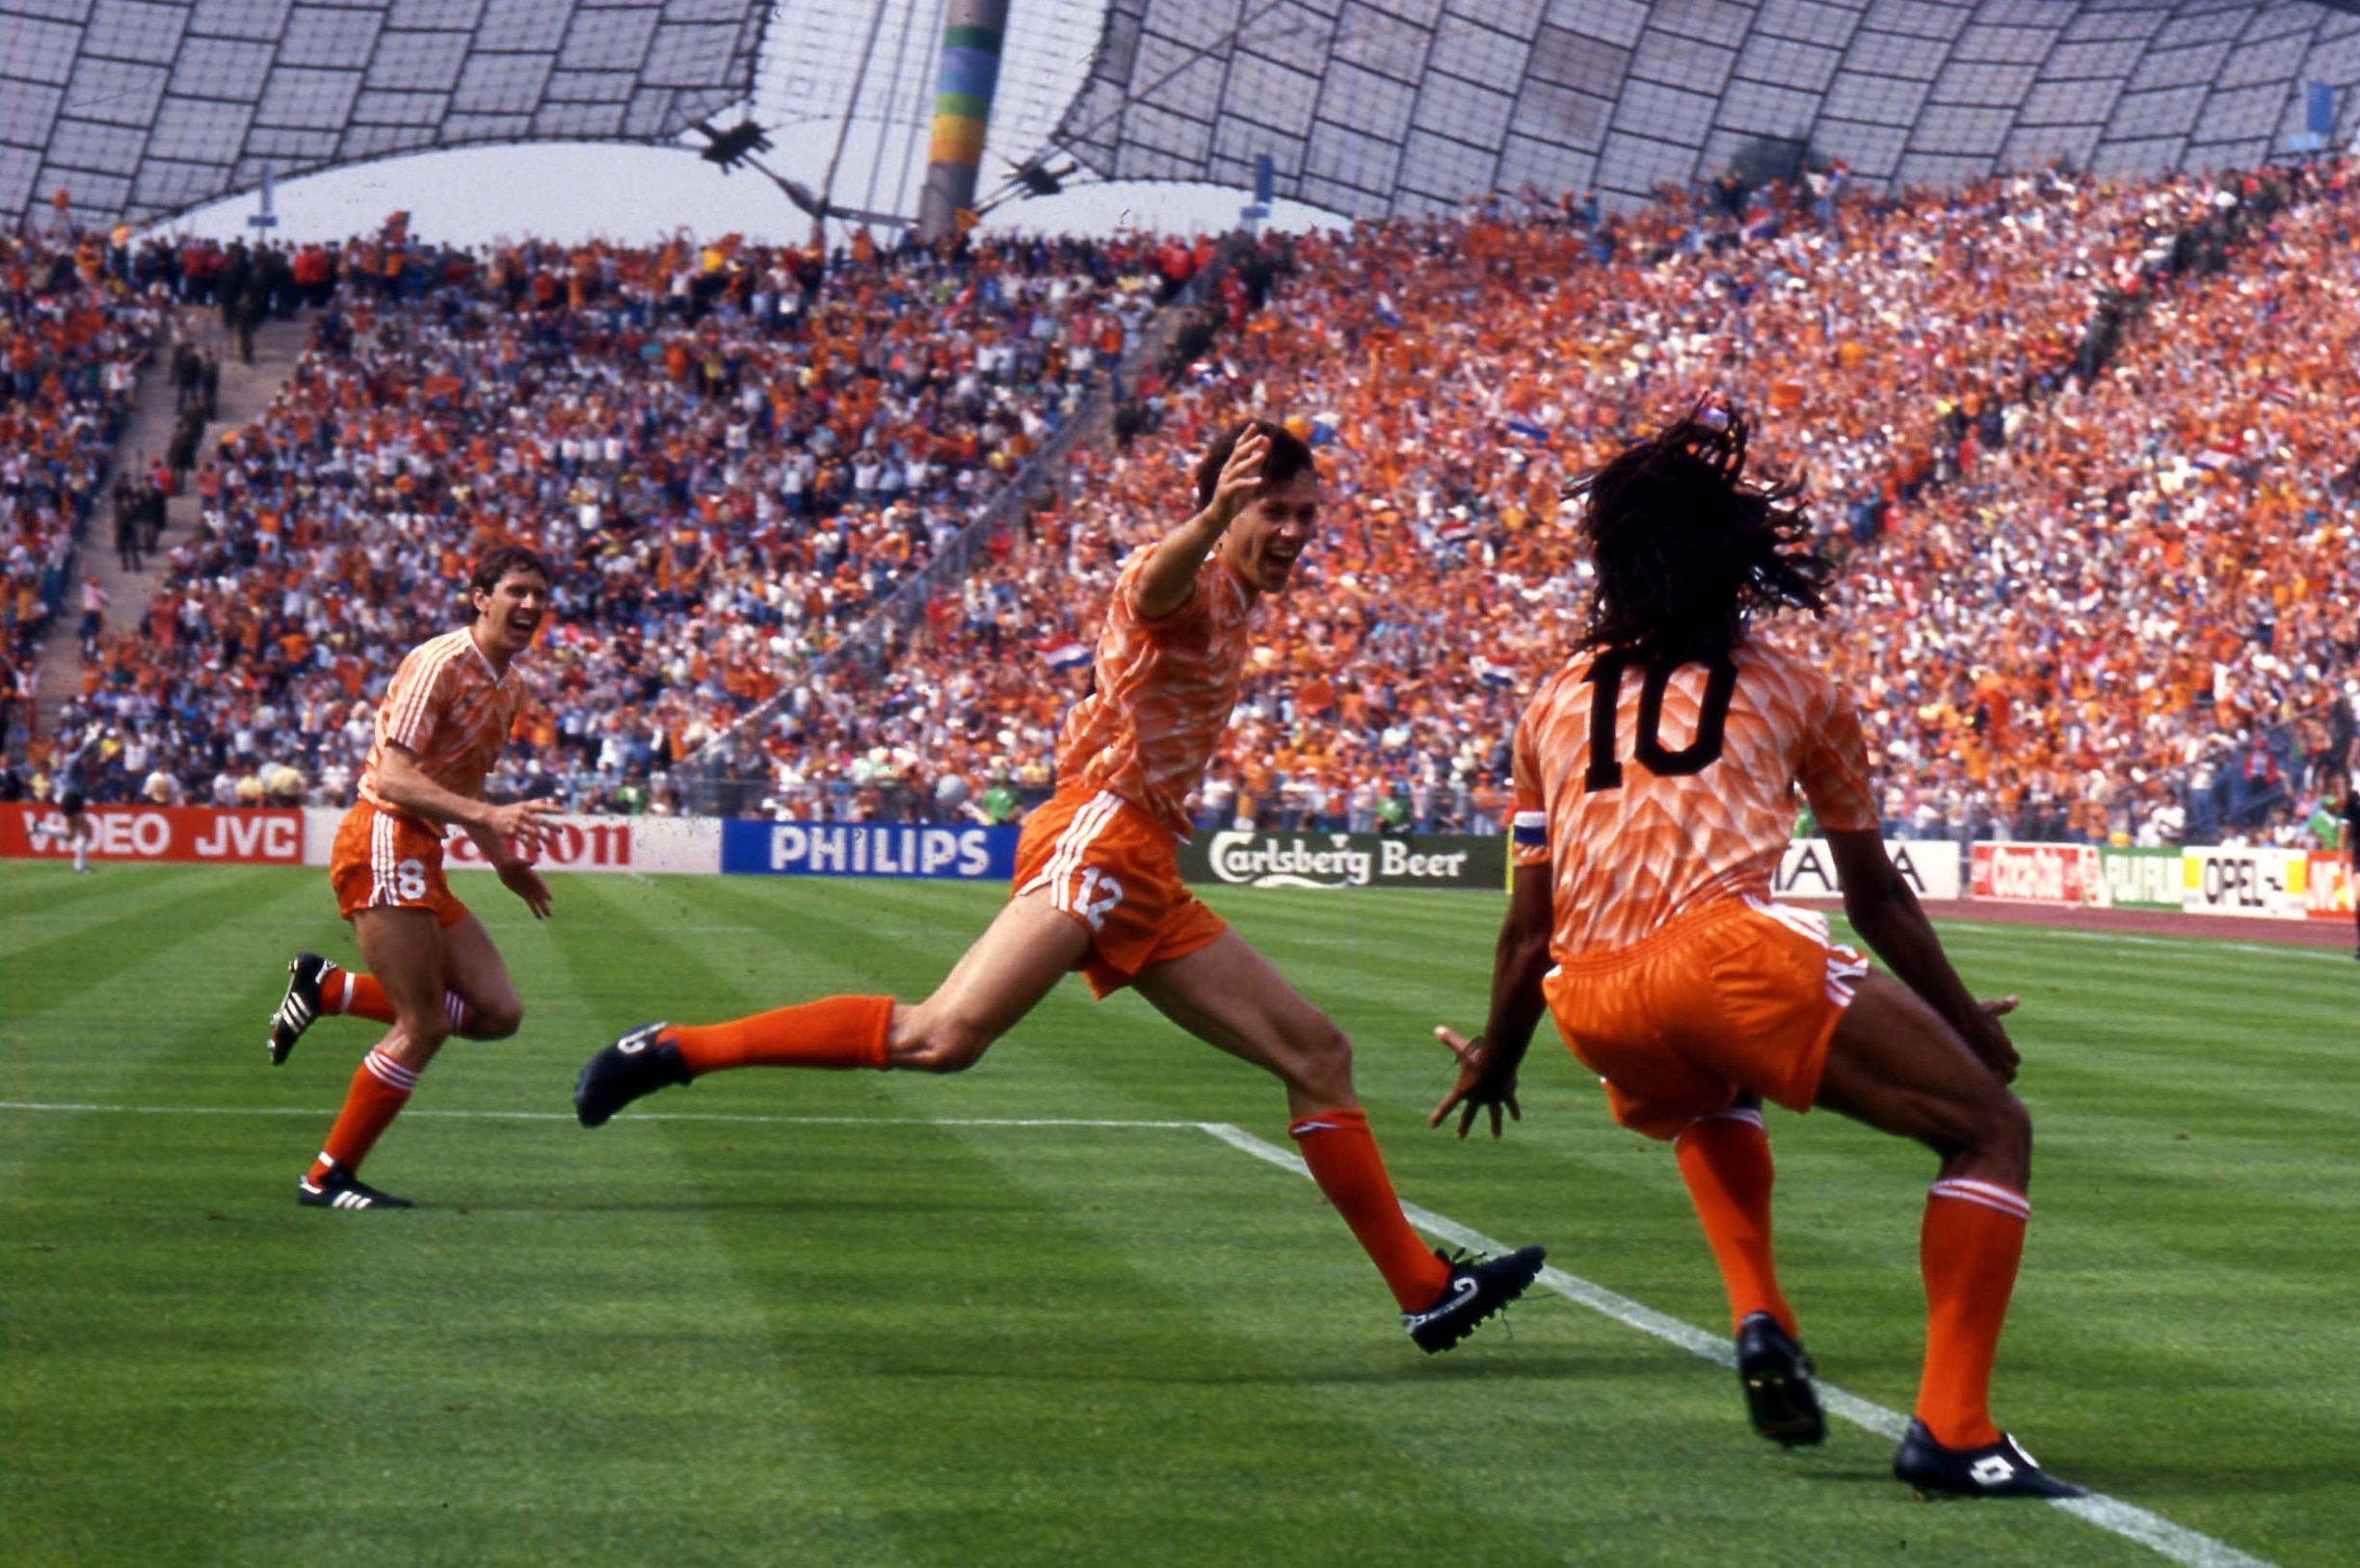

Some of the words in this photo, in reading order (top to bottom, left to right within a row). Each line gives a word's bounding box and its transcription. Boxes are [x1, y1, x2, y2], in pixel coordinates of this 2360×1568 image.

[1580, 648, 1737, 793] 10
[195, 815, 295, 857] JVC
[772, 826, 990, 875] PHILIPS
[1208, 832, 1371, 886] Carlsberg
[1381, 839, 1468, 877] Beer
[398, 859, 425, 899] 8
[1072, 865, 1123, 932] 12
[2206, 858, 2264, 907] OPEL
